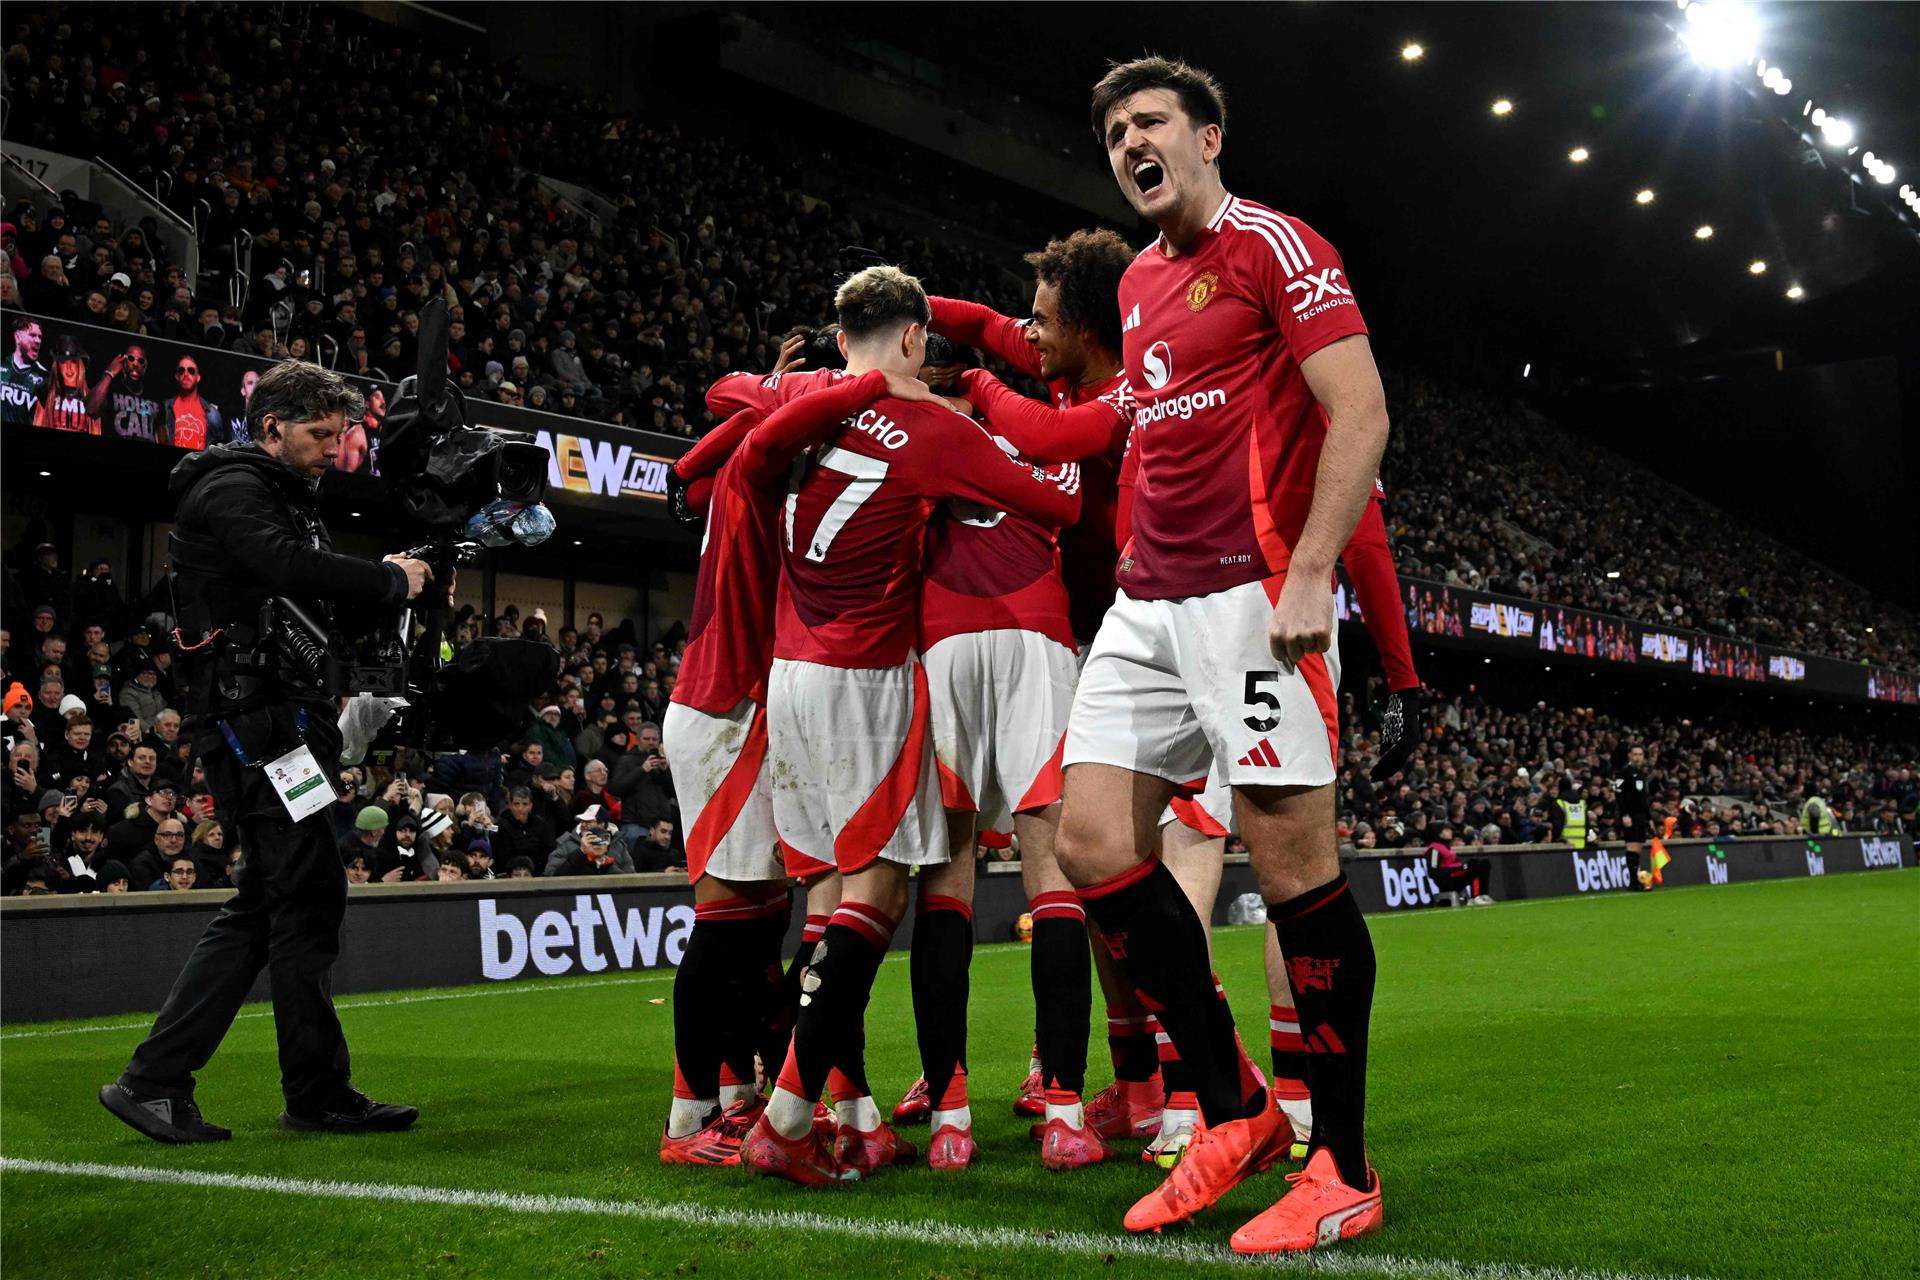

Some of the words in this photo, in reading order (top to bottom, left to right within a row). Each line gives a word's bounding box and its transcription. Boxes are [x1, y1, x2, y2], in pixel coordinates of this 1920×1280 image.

[1, 384, 38, 411] RUV
[1136, 388, 1227, 431] apdragon
[1243, 671, 1282, 732] 5
[1572, 850, 1631, 892] betwa
[1860, 837, 1903, 868] betway
[1381, 858, 1440, 907] bet
[478, 894, 696, 980] betwa
